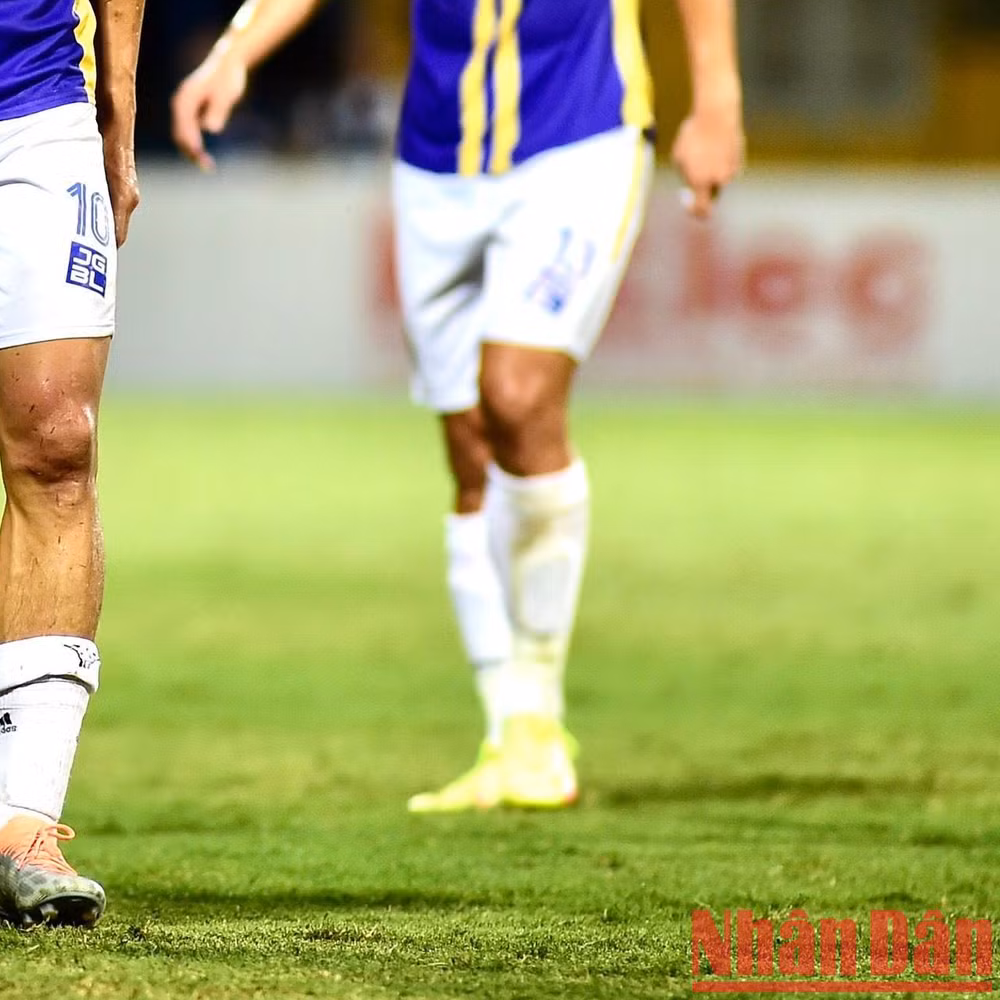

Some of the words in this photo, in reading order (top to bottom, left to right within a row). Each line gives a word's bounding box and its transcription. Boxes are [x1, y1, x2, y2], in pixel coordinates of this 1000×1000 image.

[66, 182, 110, 247] 10
[73, 246, 107, 274] JG
[70, 263, 105, 293] BL
